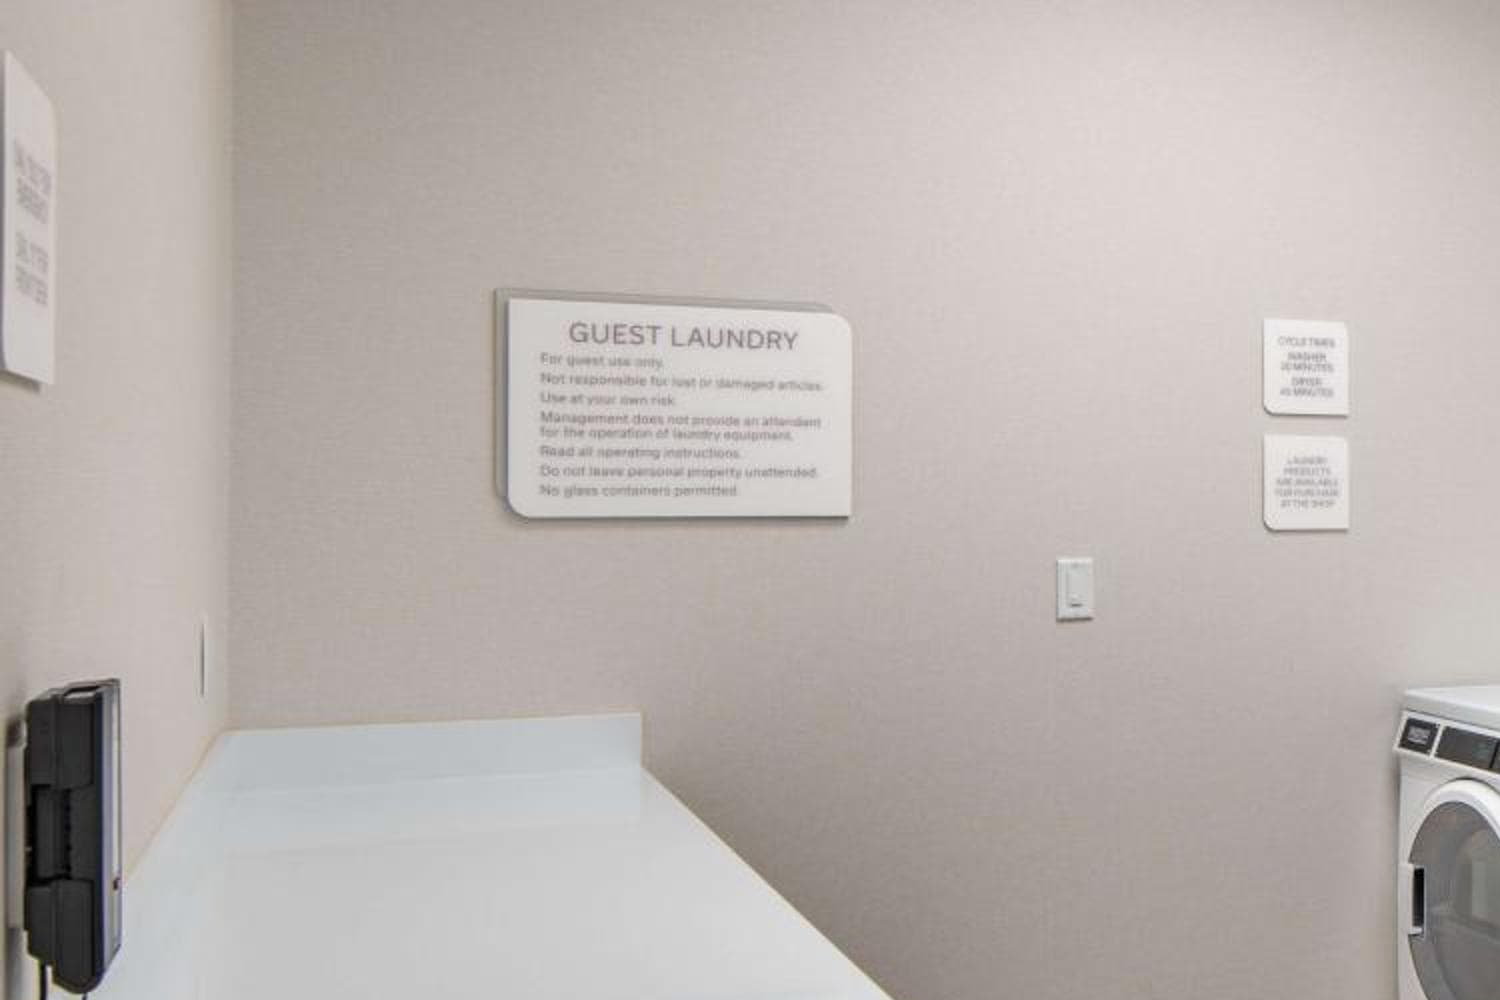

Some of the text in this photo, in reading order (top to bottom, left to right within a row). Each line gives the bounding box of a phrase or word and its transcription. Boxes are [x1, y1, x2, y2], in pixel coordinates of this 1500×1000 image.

[568, 321, 799, 350] GUEST LAUNDRY
[540, 352, 562, 365] For
[566, 355, 604, 368] guest
[608, 357, 631, 367] use
[540, 373, 566, 385] Not
[569, 374, 646, 387] responsible
[649, 376, 668, 386] for
[671, 377, 696, 388] lost
[699, 378, 713, 389] or
[716, 379, 775, 393] damaged
[540, 392, 567, 404] Use
[570, 394, 584, 404] at
[587, 397, 616, 407] your
[619, 397, 648, 406] own
[540, 411, 822, 429] Management does not provide an attendant
[540, 426, 559, 437] for
[563, 426, 585, 437] the
[588, 428, 654, 441] operation
[655, 428, 670, 439] of
[671, 430, 720, 442] laundry
[540, 446, 575, 457] Read
[578, 447, 593, 457] all
[597, 447, 661, 460] operating
[540, 464, 560, 477] Do
[563, 466, 585, 477] not
[589, 466, 624, 477] leave
[627, 466, 685, 479] personal
[687, 467, 742, 480] property
[540, 484, 560, 497] No
[563, 486, 599, 499] glass
[601, 486, 671, 497] containers
